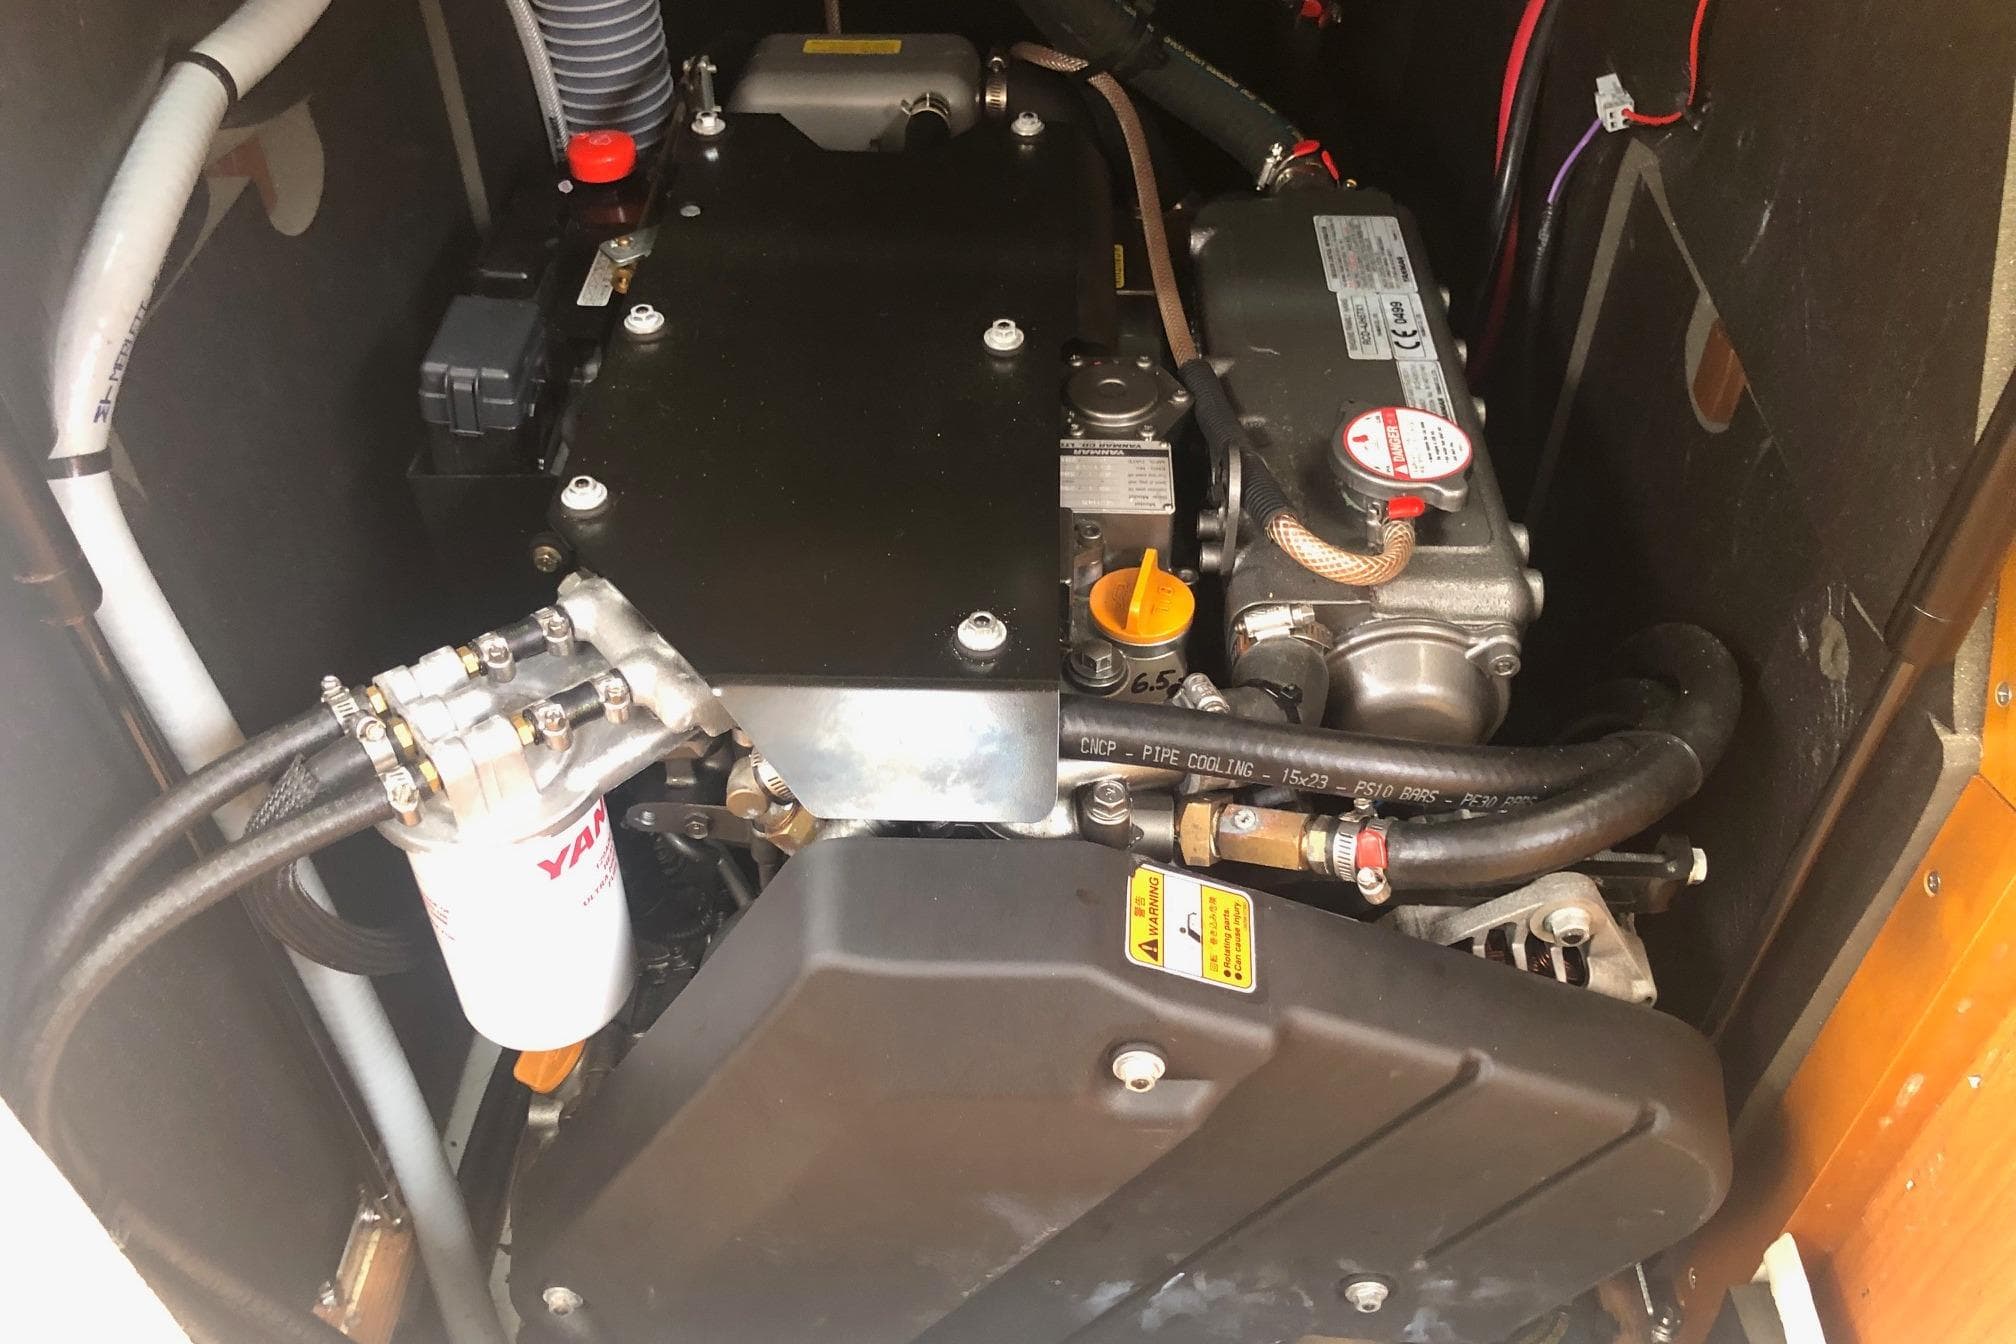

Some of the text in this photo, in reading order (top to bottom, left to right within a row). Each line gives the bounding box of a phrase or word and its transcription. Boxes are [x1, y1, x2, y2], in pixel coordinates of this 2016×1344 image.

[1389, 301, 1408, 325] 0499
[1387, 425, 1405, 463] DANGER
[1080, 736, 1117, 757] CNCP
[1142, 744, 1181, 767] PIPE
[1187, 753, 1254, 778] COOLING
[1281, 767, 1329, 790] 15x23
[1353, 779, 1393, 799] PS10
[1400, 786, 1439, 804] BARS
[1459, 792, 1498, 808] PE30
[1134, 896, 1146, 917] 警告
[1147, 876, 1160, 936] WARNING
[1223, 907, 1232, 969] Rotating parts.
[1235, 926, 1243, 953] cause
[1234, 955, 1243, 972] Can
